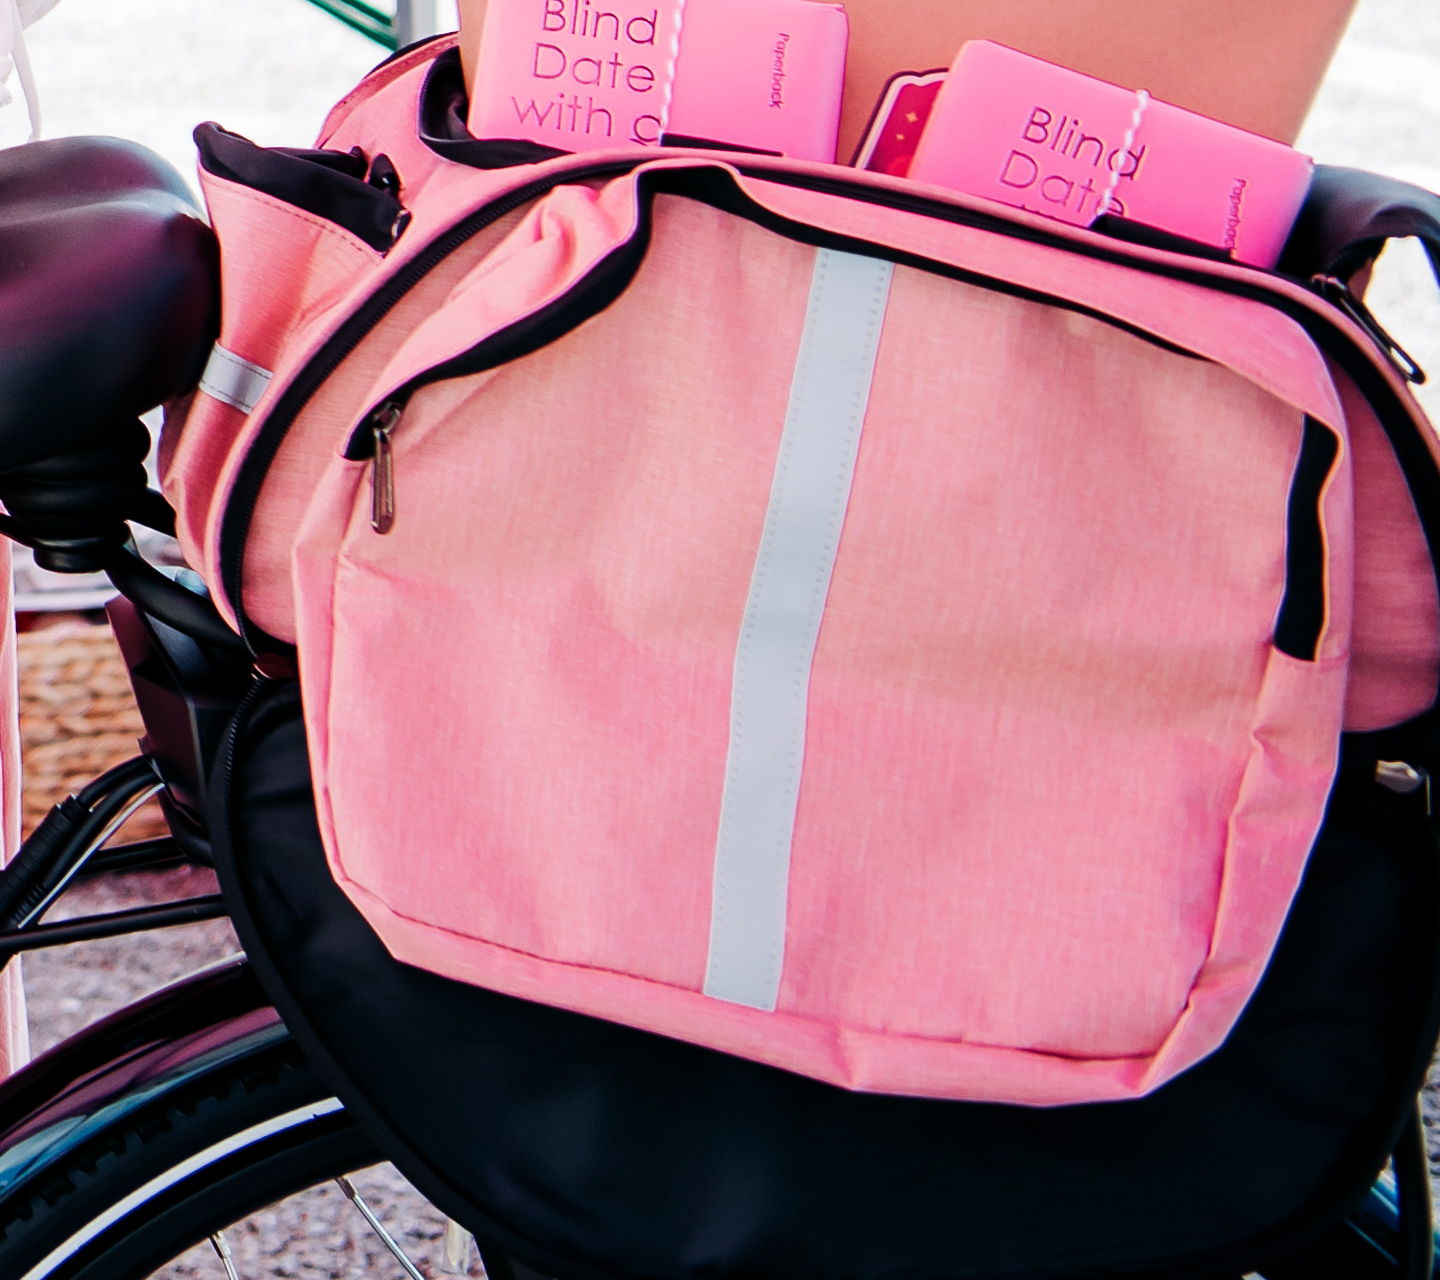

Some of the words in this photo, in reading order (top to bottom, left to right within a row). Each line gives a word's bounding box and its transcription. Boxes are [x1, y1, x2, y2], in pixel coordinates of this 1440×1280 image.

[532, 42, 656, 93] Date
[768, 32, 790, 110] Paperback
[511, 93, 613, 138] with
[1020, 105, 1147, 181] Blind
[998, 148, 1125, 217] Date
